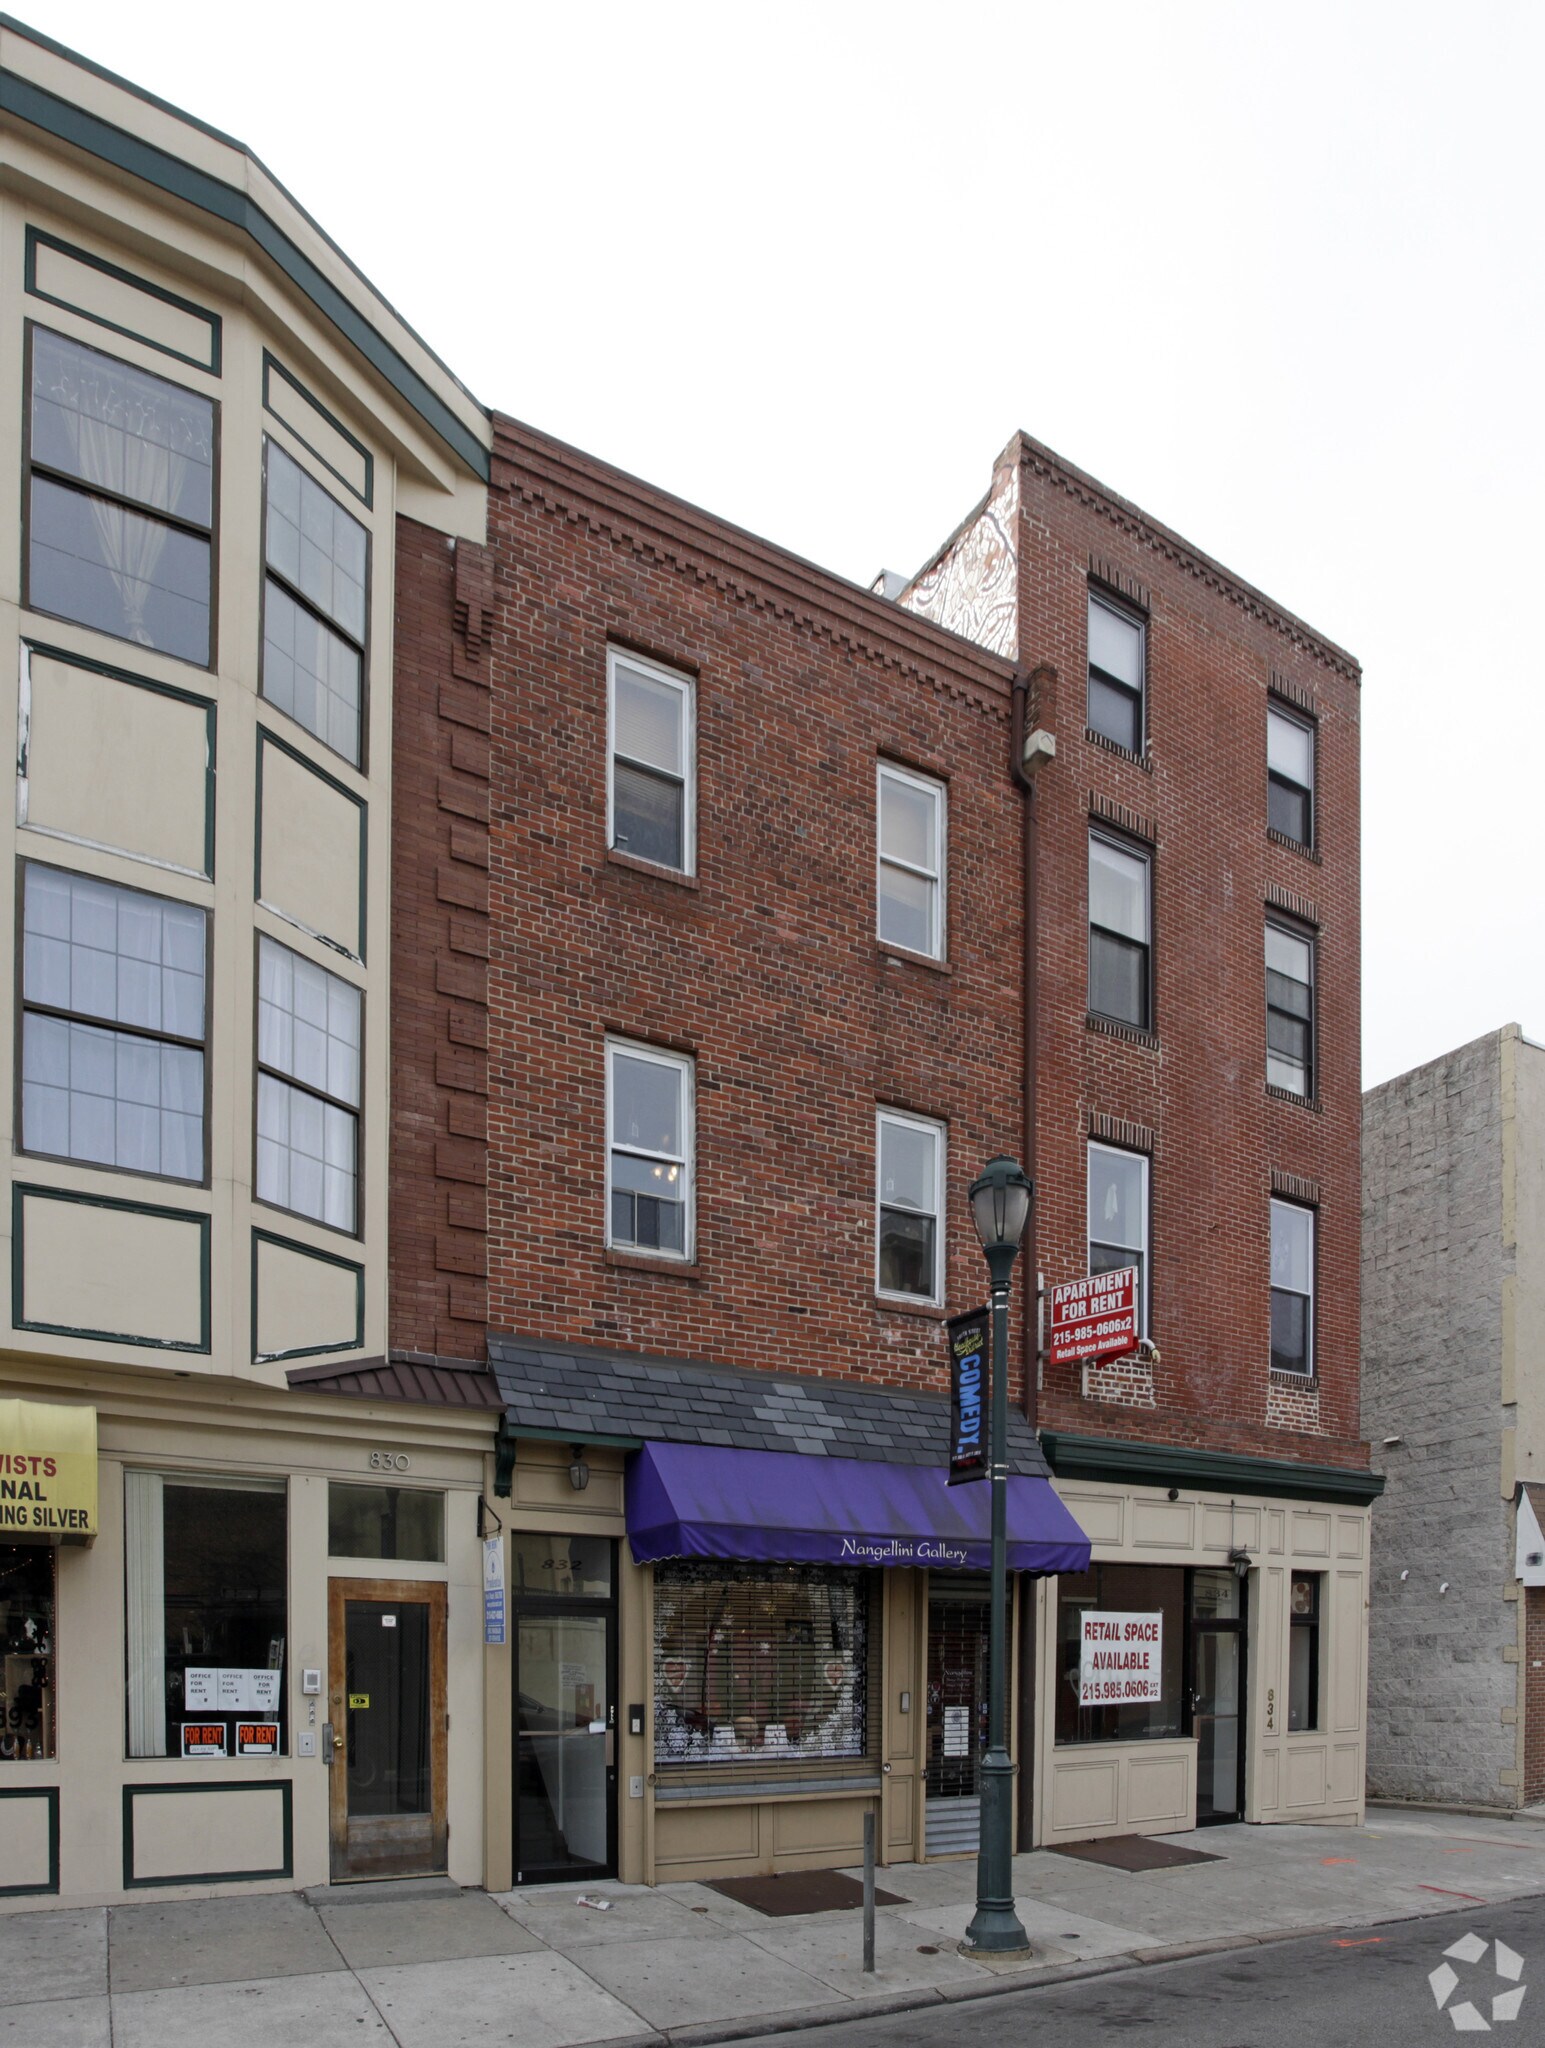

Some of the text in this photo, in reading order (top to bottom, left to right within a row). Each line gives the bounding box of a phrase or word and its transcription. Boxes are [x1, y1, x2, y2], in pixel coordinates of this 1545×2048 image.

[1055, 1270, 1131, 1304] APARTMENT
[1062, 1290, 1124, 1320] FOR RENT
[1053, 1316, 1132, 1346] 215-985-0606x2
[1056, 1336, 1128, 1359] Retail Space Available
[370, 1451, 410, 1471] 830
[1, 1480, 47, 1501] NAL
[33, 1506, 89, 1529] SILVER
[840, 1538, 967, 1564] Nangellini Gallery
[541, 1558, 583, 1571] 832
[1084, 1622, 1159, 1642] RETAIL SPACE
[1092, 1651, 1150, 1671] AVAILABLE
[1082, 1679, 1149, 1700] 215.985.0606
[1266, 1688, 1275, 1730] 834
[185, 1727, 223, 1744] FOR RENT
[239, 1726, 276, 1743] FOR RENT
